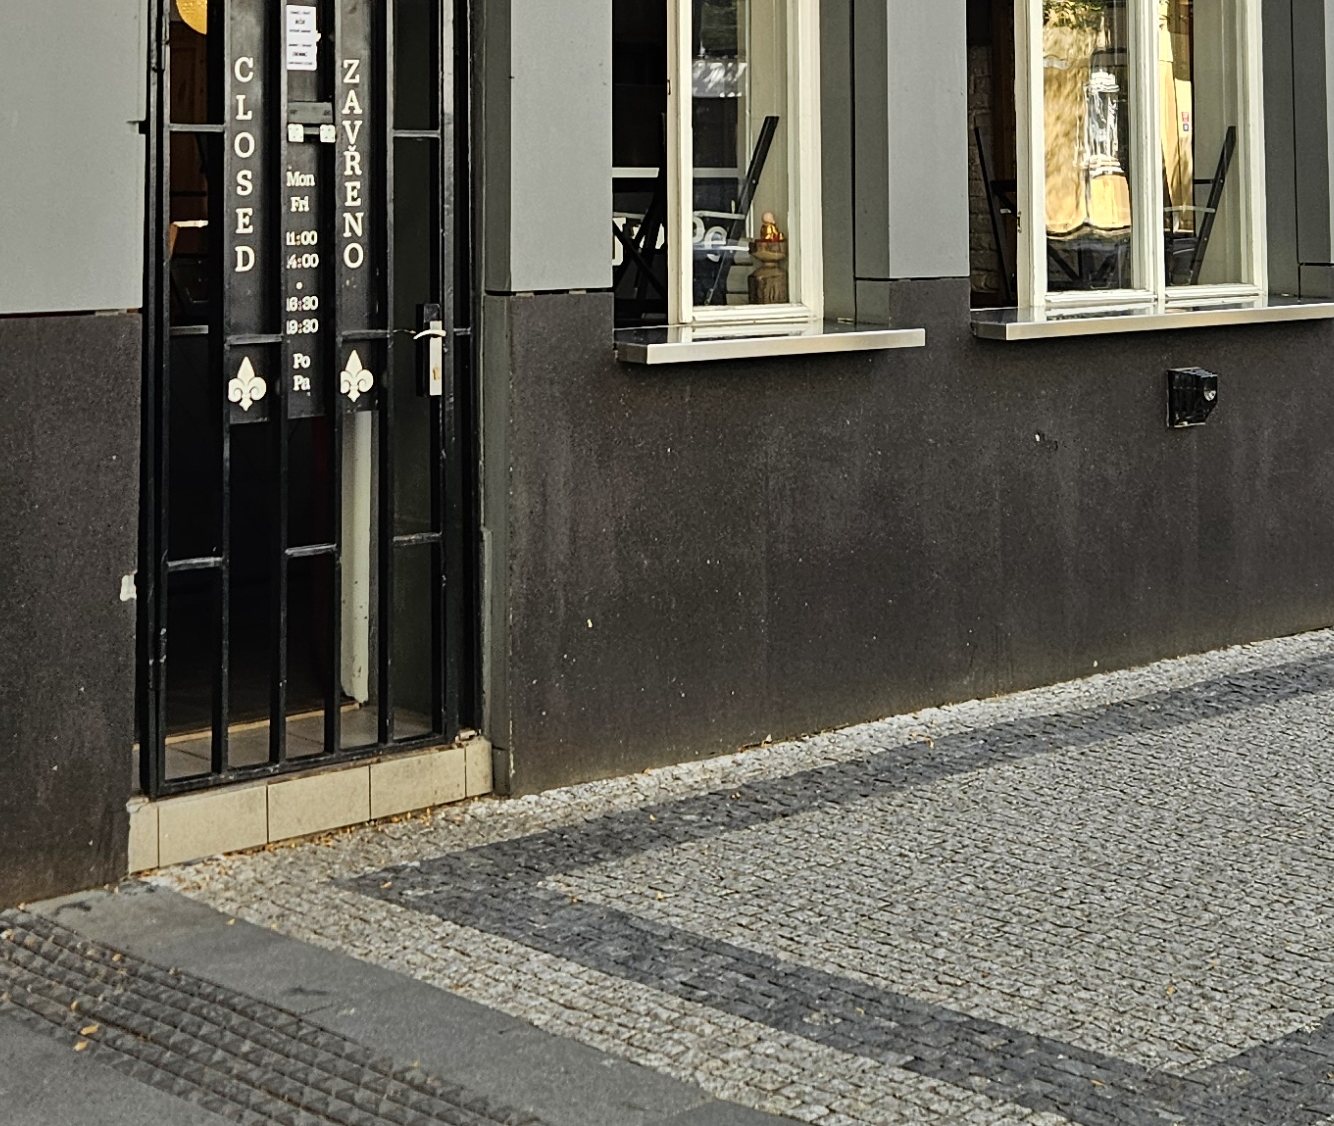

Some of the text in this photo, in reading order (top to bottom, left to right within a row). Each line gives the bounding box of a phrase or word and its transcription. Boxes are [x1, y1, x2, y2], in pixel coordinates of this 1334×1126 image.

[234, 56, 255, 272] CLOSED
[341, 59, 364, 269] ZAVŘENO
[286, 171, 316, 187] Mon
[290, 195, 310, 212] Fri
[286, 253, 319, 269] 4:00
[292, 352, 311, 369] Po
